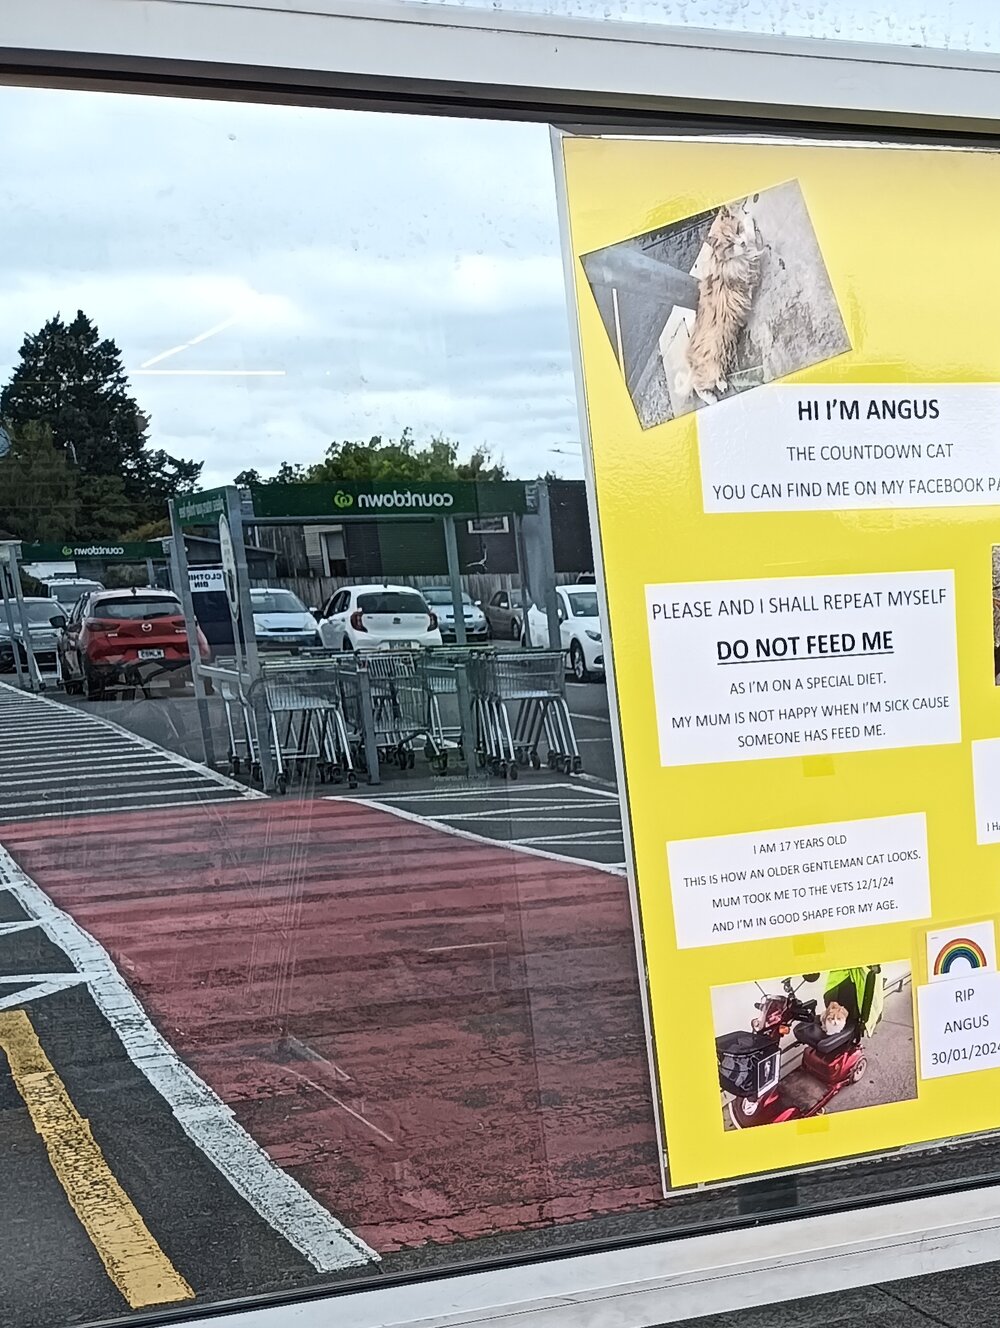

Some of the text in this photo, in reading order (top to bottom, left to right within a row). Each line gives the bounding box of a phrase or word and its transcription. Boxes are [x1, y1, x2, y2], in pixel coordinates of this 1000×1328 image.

[797, 398, 940, 421] HI I'M ANGUS
[785, 442, 954, 462] THE COUNTDOWN CAT
[711, 483, 746, 500] YOU
[749, 482, 782, 499] CAN
[786, 481, 822, 498] FIND
[826, 480, 850, 497] ME
[853, 480, 877, 496] ON
[880, 479, 905, 495] MY
[908, 477, 984, 494] FACEBOOK
[651, 600, 713, 620] PLEASE
[717, 598, 755, 617] AND
[768, 595, 820, 614] SHALL
[822, 591, 883, 610] REPEAT
[887, 587, 947, 607] MYSELF
[716, 630, 894, 661] DO NOT FEED ME
[729, 671, 887, 695] AS I'M ON A SPECIAL DIET.
[671, 695, 950, 729] MY MUM IS NOT HAPPY WHEN I'M SICK CAUSE
[736, 723, 886, 748] SOMEONE HAS FEED ME.
[758, 842, 777, 854] AM
[779, 840, 792, 852] 17
[792, 836, 825, 850] YEARS
[826, 834, 847, 847] OLD
[682, 848, 921, 888] THIS IS HOW AN OLDER GENTLEMAN CAT LOOKS.
[711, 875, 894, 909] MUM TOOK ME TO THE VETS 12/1/24
[711, 898, 899, 933] AND I'M IN GOOD SHAPE FOR MY AGE.
[954, 987, 975, 1003] RIP
[943, 1013, 990, 1034] ANGUS
